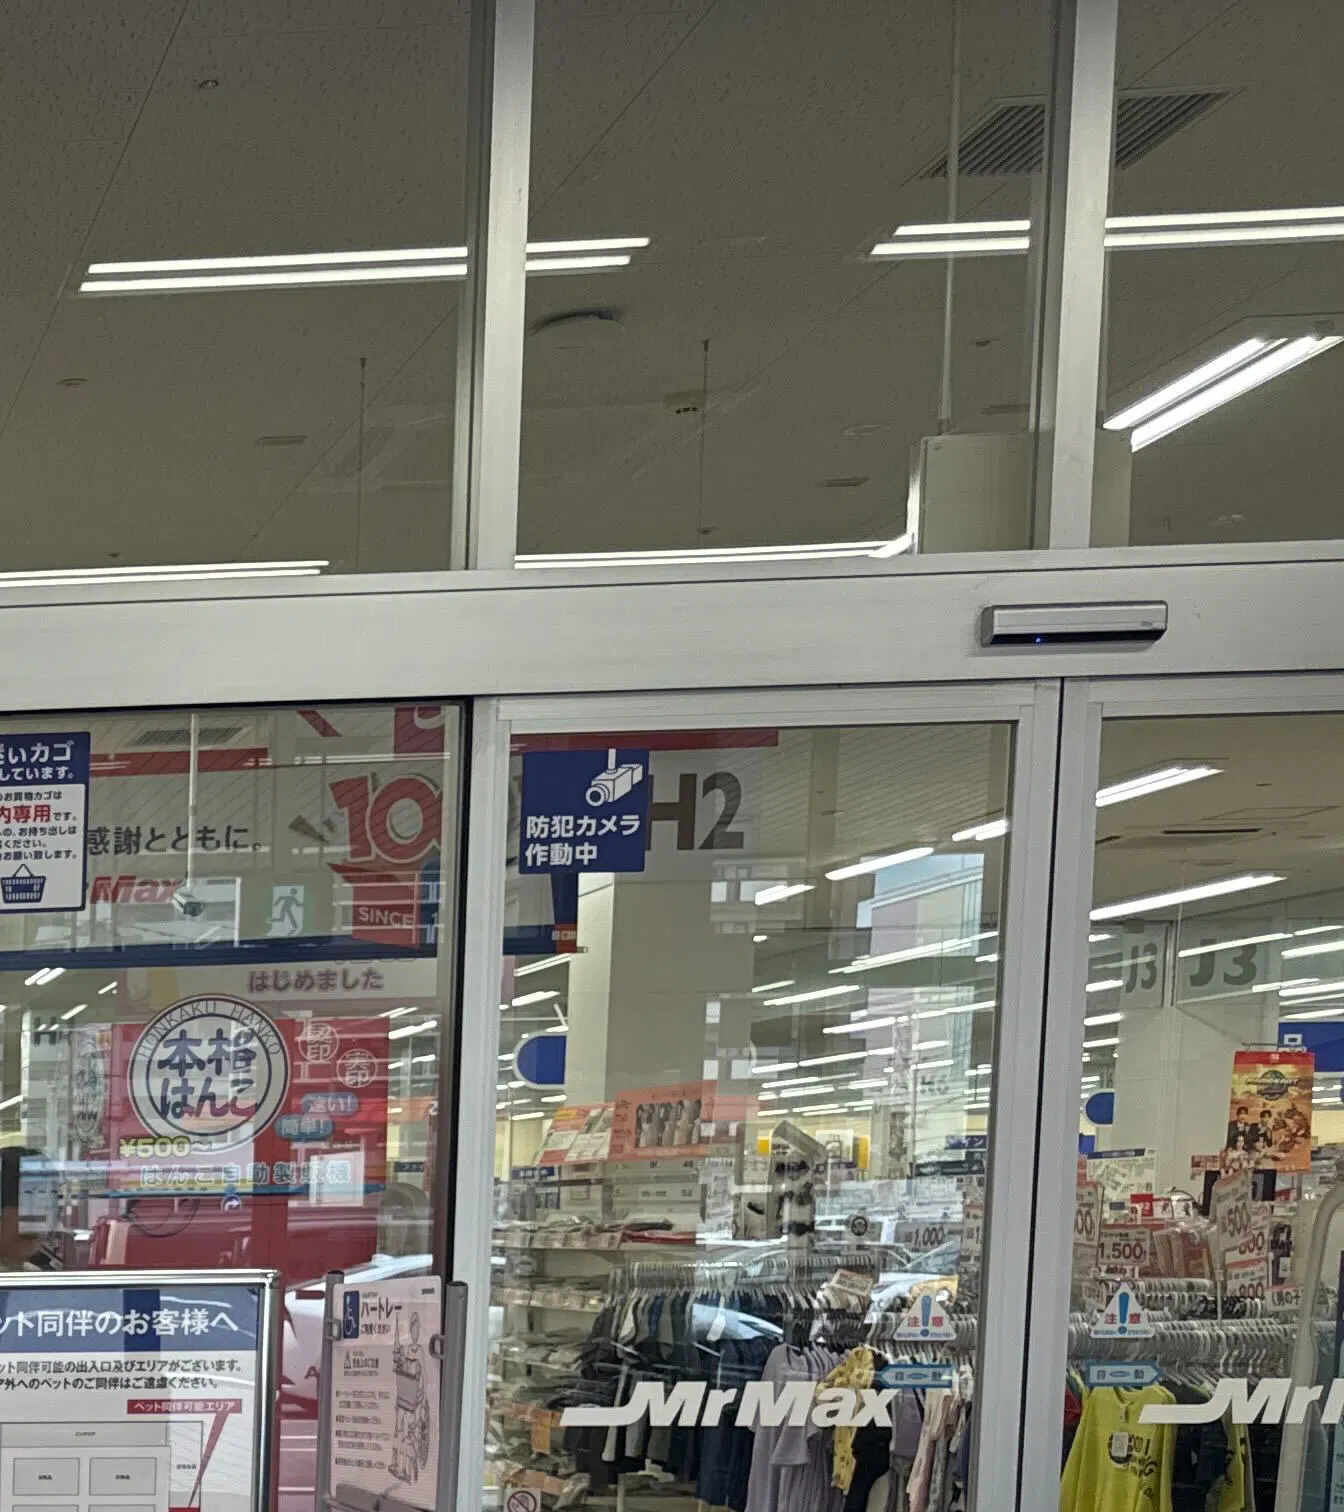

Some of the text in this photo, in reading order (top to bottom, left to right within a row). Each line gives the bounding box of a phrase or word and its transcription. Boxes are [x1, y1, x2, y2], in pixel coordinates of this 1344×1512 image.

[526, 815, 641, 840] 防犯カメラ
[525, 843, 598, 866] 作動中
[249, 968, 384, 993] はじめました
[158, 1026, 258, 1076] 本格
[161, 1076, 259, 1119] はんこ
[559, 1380, 899, 1427] MrMax
